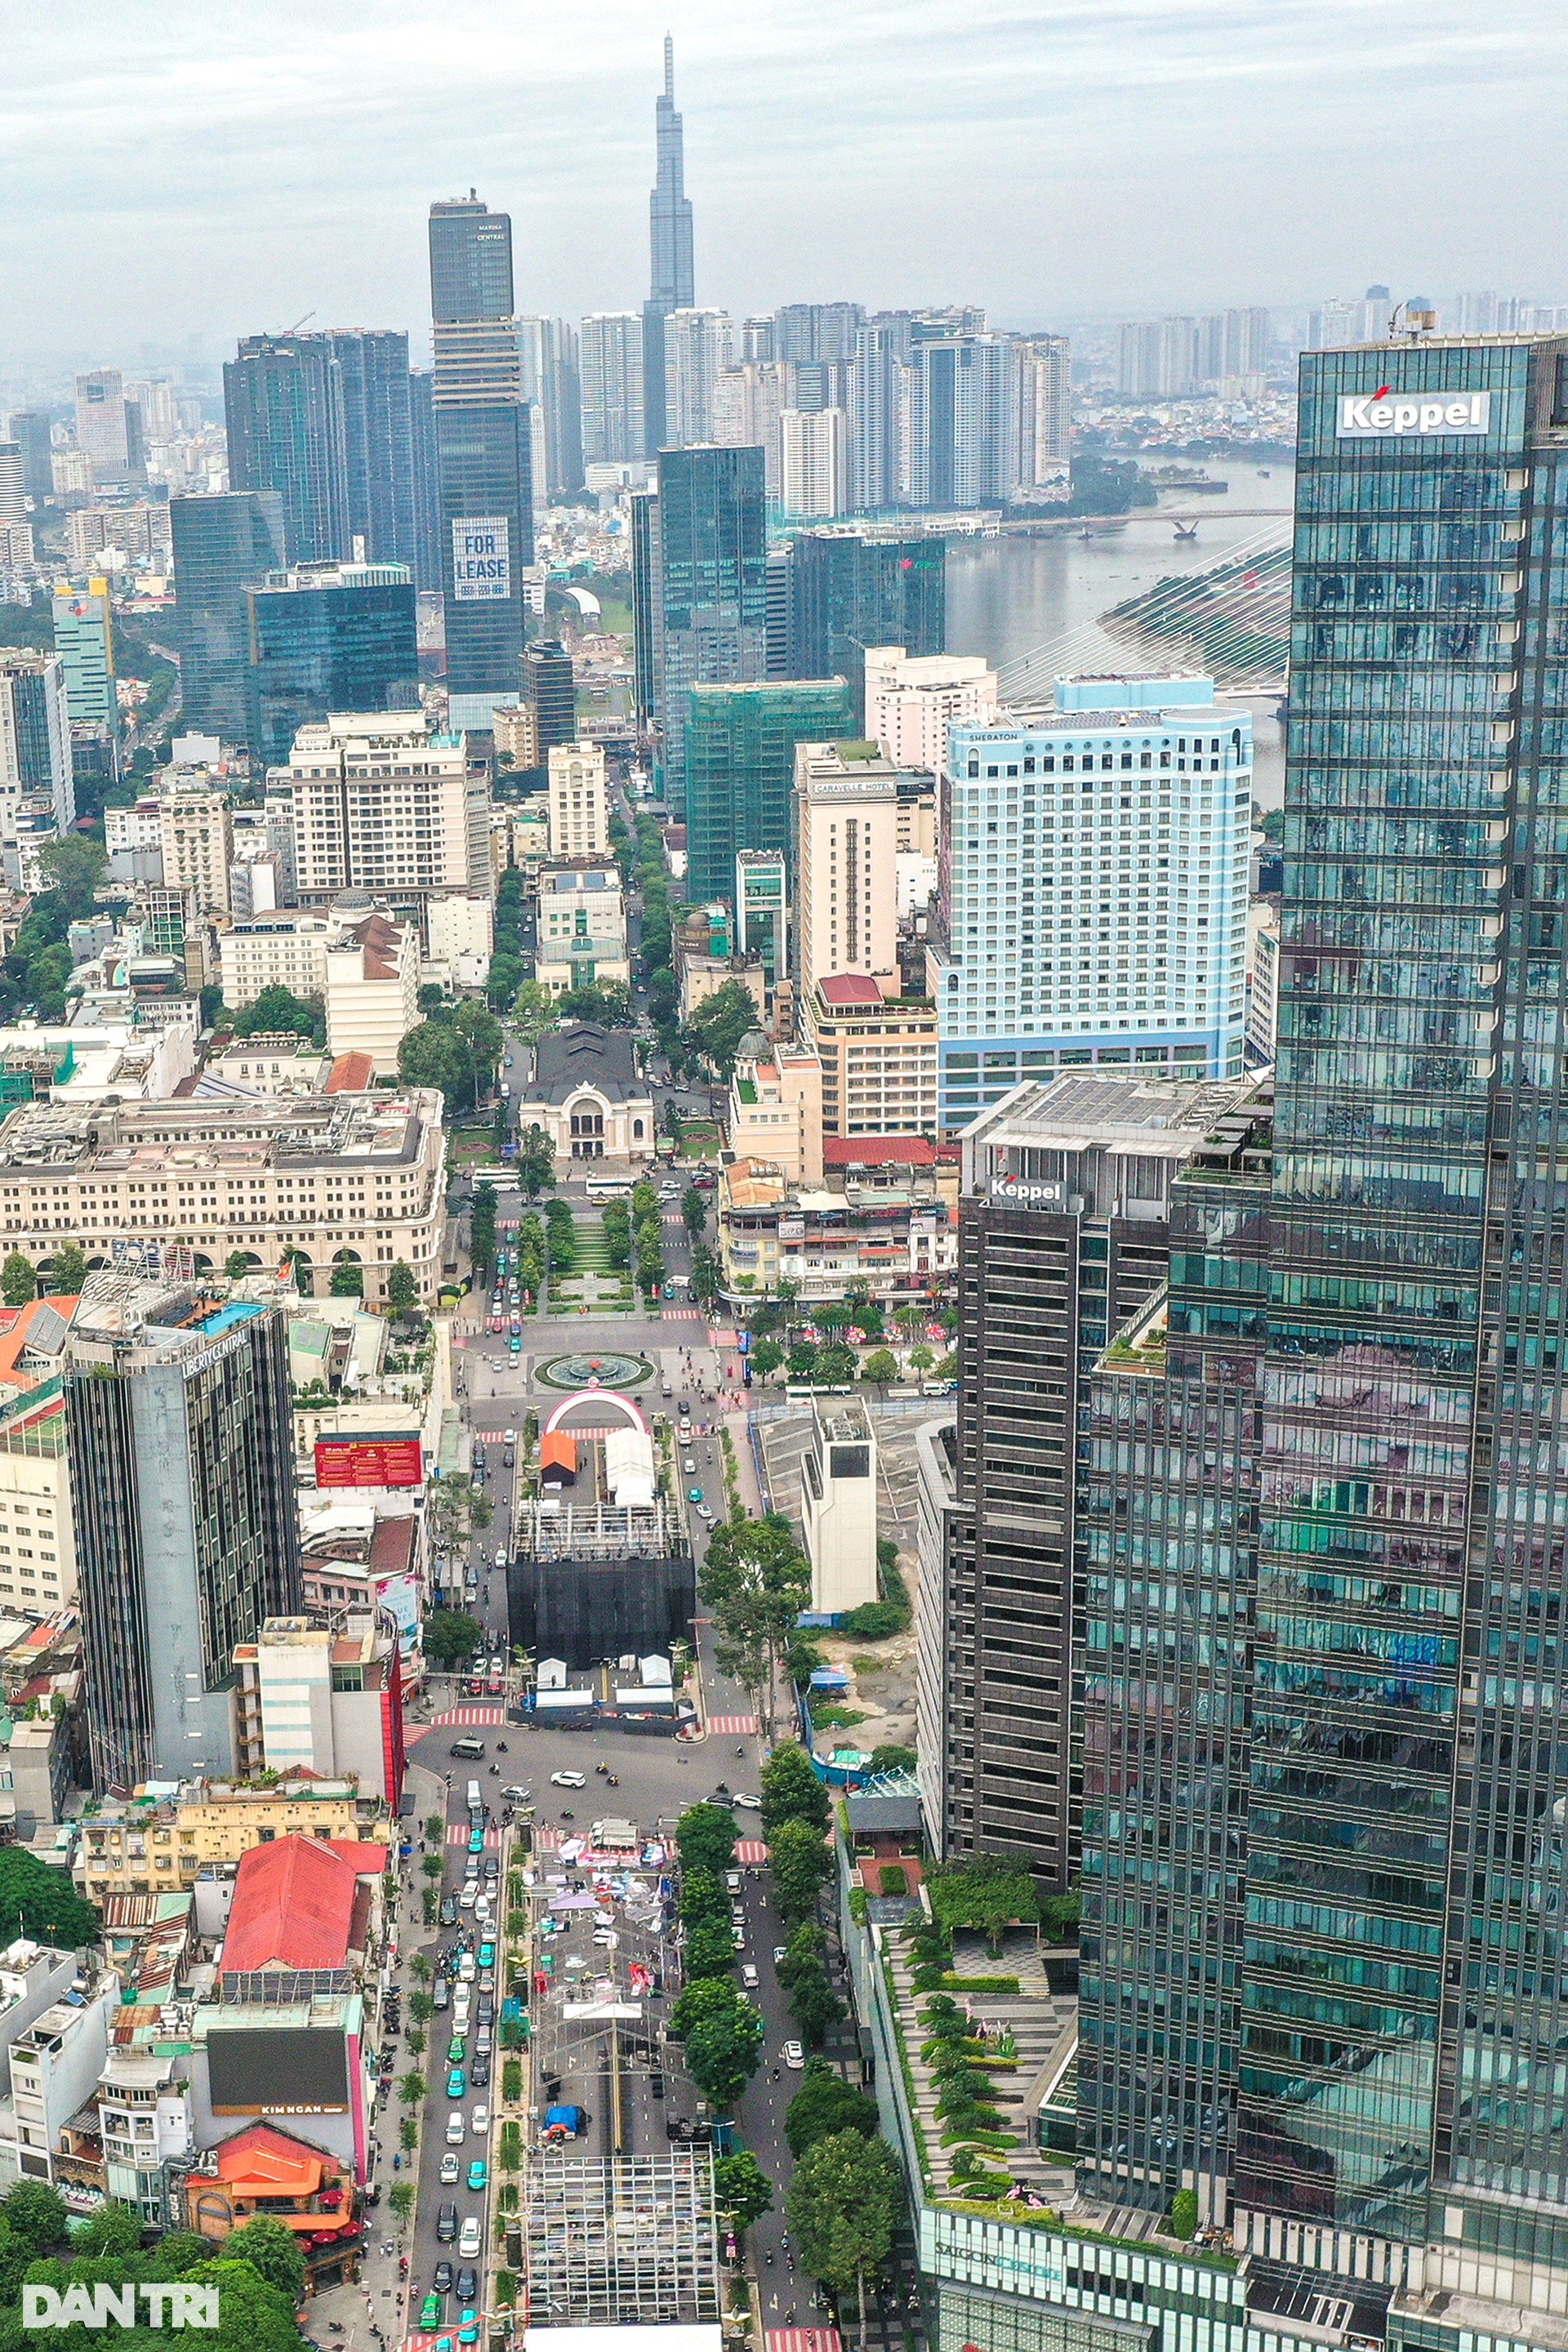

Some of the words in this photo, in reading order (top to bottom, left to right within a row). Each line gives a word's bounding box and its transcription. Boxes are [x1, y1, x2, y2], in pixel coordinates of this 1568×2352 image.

[1343, 386, 1482, 434] Keppel
[466, 535, 495, 555] FOR
[457, 559, 506, 580] LEASE
[969, 733, 1018, 742] SHERATON
[817, 784, 862, 792] CARAVELLE
[991, 1175, 1061, 1201] Keppel
[261, 2106, 285, 2114] KIM
[287, 2105, 322, 2114] NGAN
